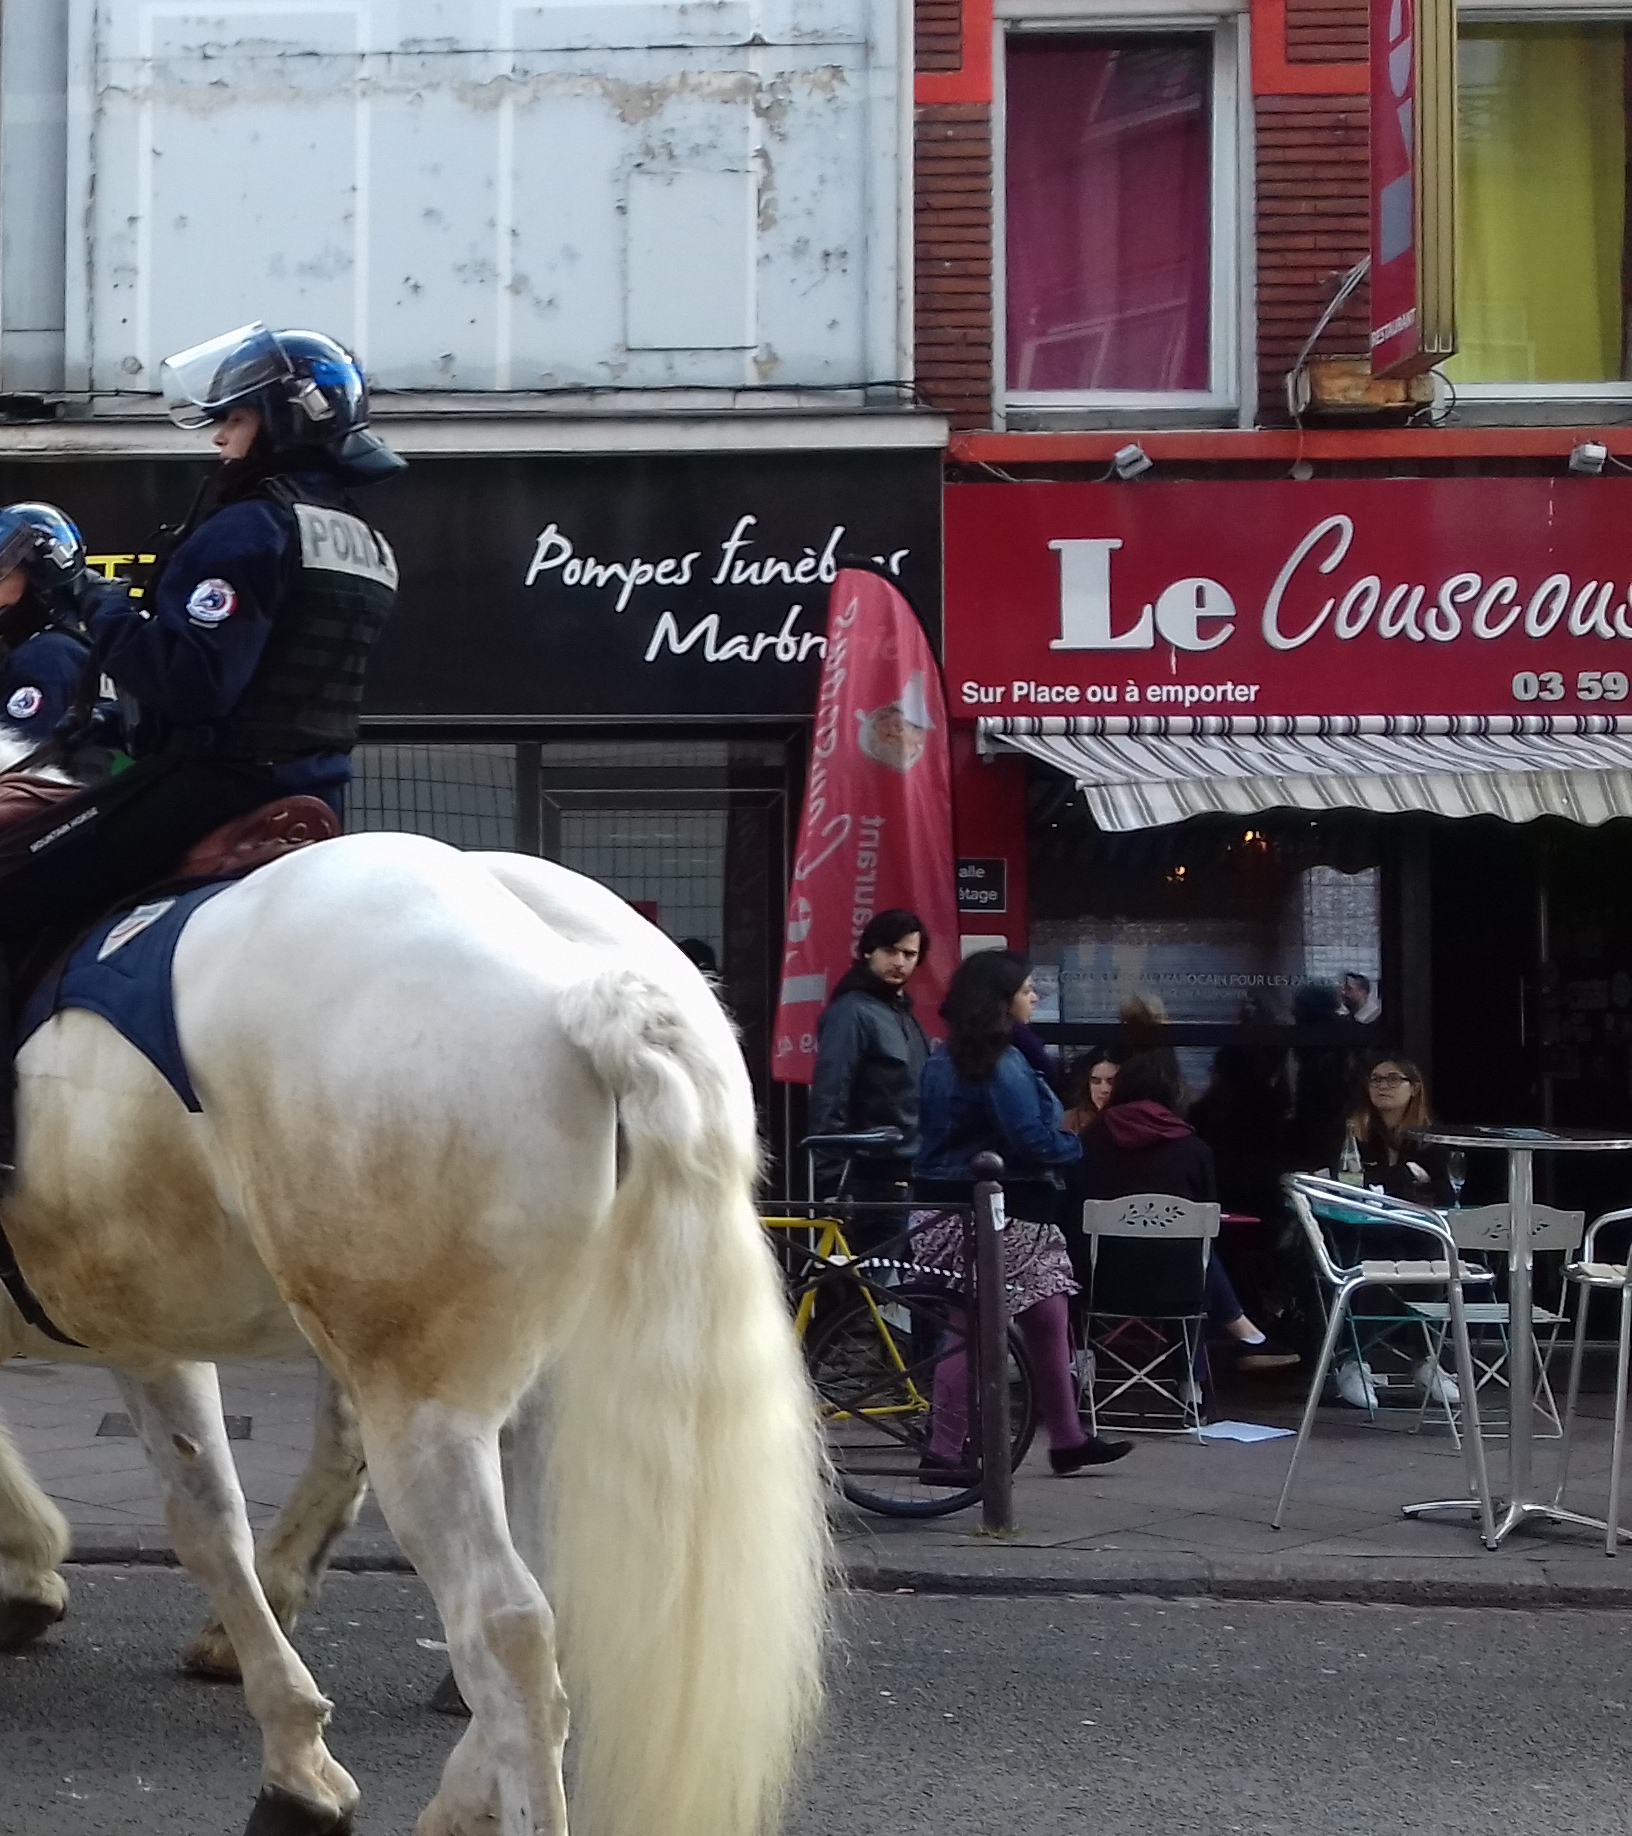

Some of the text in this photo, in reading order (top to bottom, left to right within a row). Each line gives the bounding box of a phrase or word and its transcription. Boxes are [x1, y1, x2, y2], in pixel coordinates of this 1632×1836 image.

[525, 514, 910, 613] Pompes funèbs
[1048, 537, 1236, 651] Le
[961, 679, 1260, 708] Sur Place ou à emporter
[1512, 671, 1629, 701] 03 59
[958, 865, 986, 878] alle
